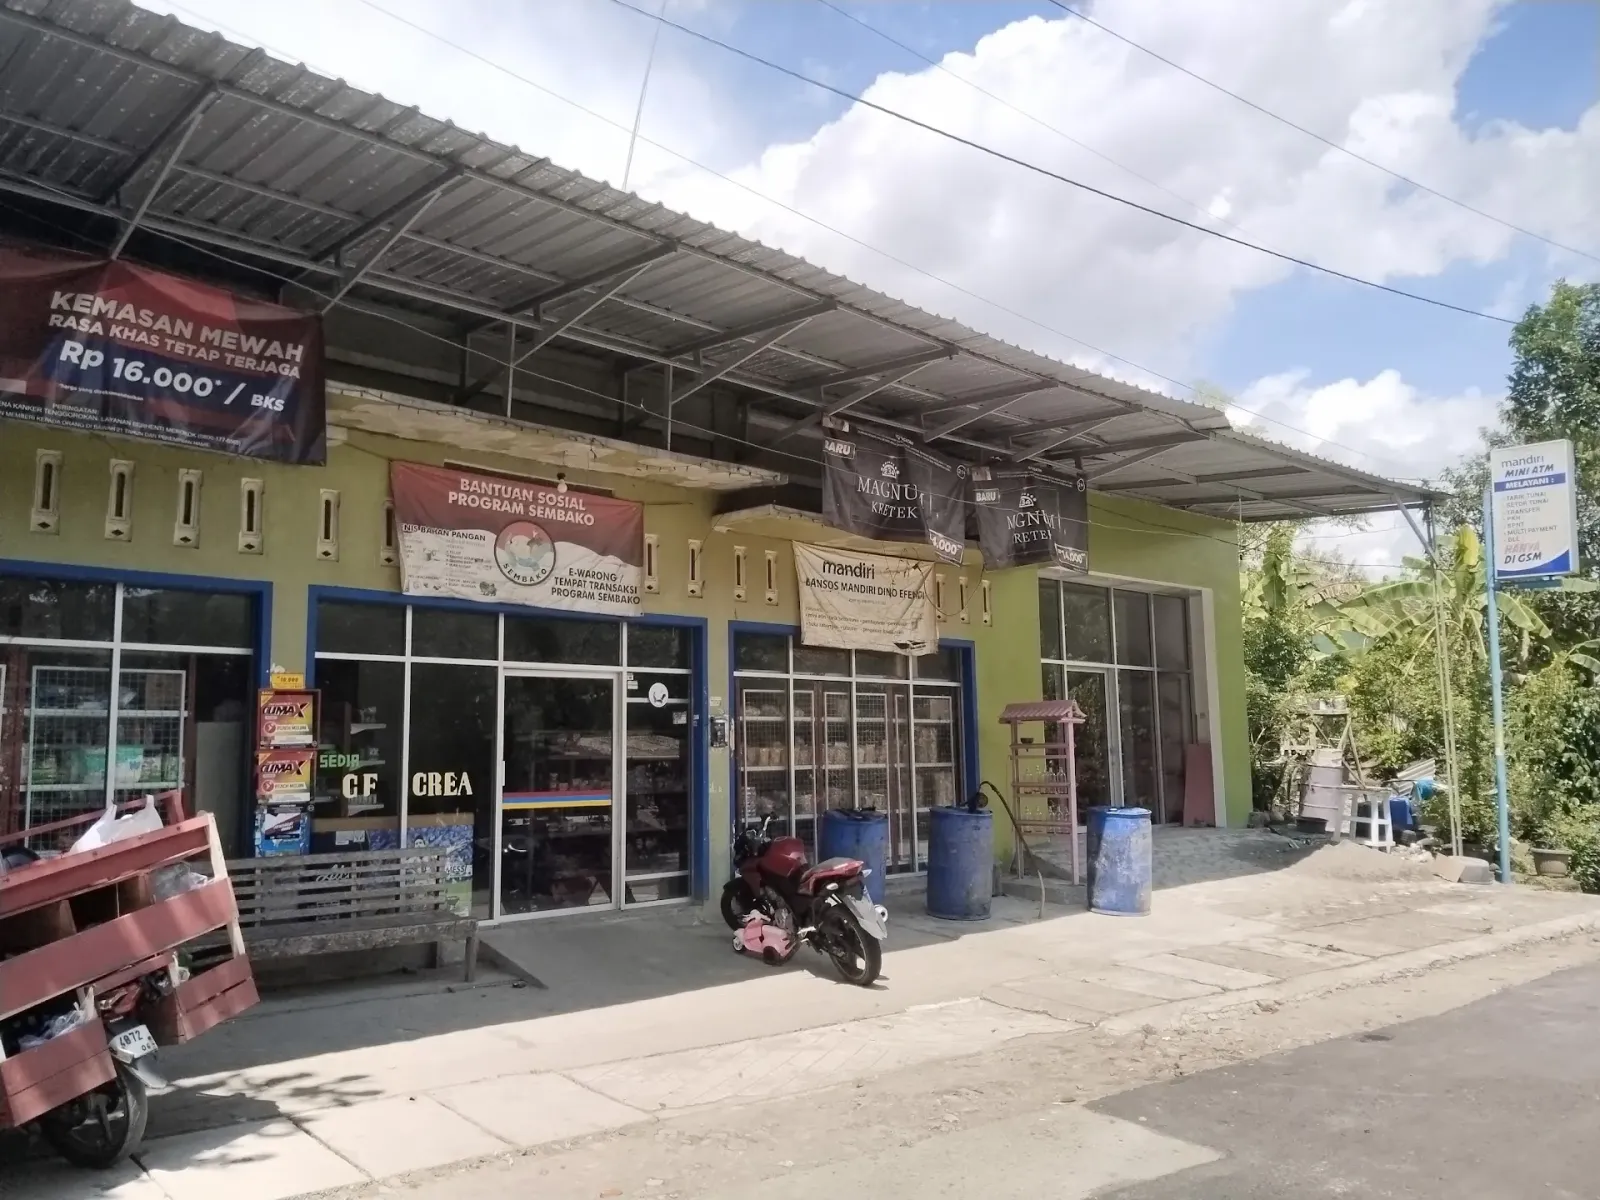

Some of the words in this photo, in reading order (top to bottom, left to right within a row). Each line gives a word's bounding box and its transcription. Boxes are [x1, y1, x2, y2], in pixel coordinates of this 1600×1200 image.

[50, 291, 193, 340] KEMASAN
[200, 326, 304, 362] MEWAH
[49, 314, 103, 335] RASA
[109, 324, 159, 348] KHAS
[165, 339, 220, 361] TETAP
[224, 352, 301, 379] TERJAGA
[59, 340, 104, 370] Rp
[224, 382, 247, 405] /
[250, 393, 285, 412] BKS
[13, 403, 42, 413] KANKER
[1501, 455, 1544, 468] mandiri
[1505, 467, 1530, 478] MINI
[1532, 464, 1554, 474] ATM
[460, 478, 534, 502] BANTUAN
[538, 492, 587, 512] SOSIAL
[976, 492, 996, 502] BARU
[448, 491, 524, 516] PROGRAM
[529, 504, 595, 526] SEMBAKO
[871, 501, 918, 519] KRETEK
[1507, 507, 1540, 515] TRANSFER
[451, 531, 486, 541] PANGAN
[1507, 528, 1526, 536] MULTI
[1528, 525, 1557, 533] PAYMENT
[1504, 555, 1515, 564] DI
[1517, 552, 1542, 563] GSM
[503, 563, 547, 583] SEMBAKO
[568, 567, 617, 582] E-WARONG
[822, 560, 875, 579] mandiri
[554, 576, 587, 589] TEMPAT
[589, 581, 638, 594] TRANSAKSI
[805, 578, 839, 590] BANSOS
[840, 582, 876, 595] MANDIRI
[877, 587, 898, 598] DINO
[899, 589, 925, 600] EFENDI
[551, 587, 595, 600] PROGRAM
[598, 592, 641, 605] SEMBAKO
[319, 754, 360, 768] SEDIA
[412, 771, 473, 797] CREA
